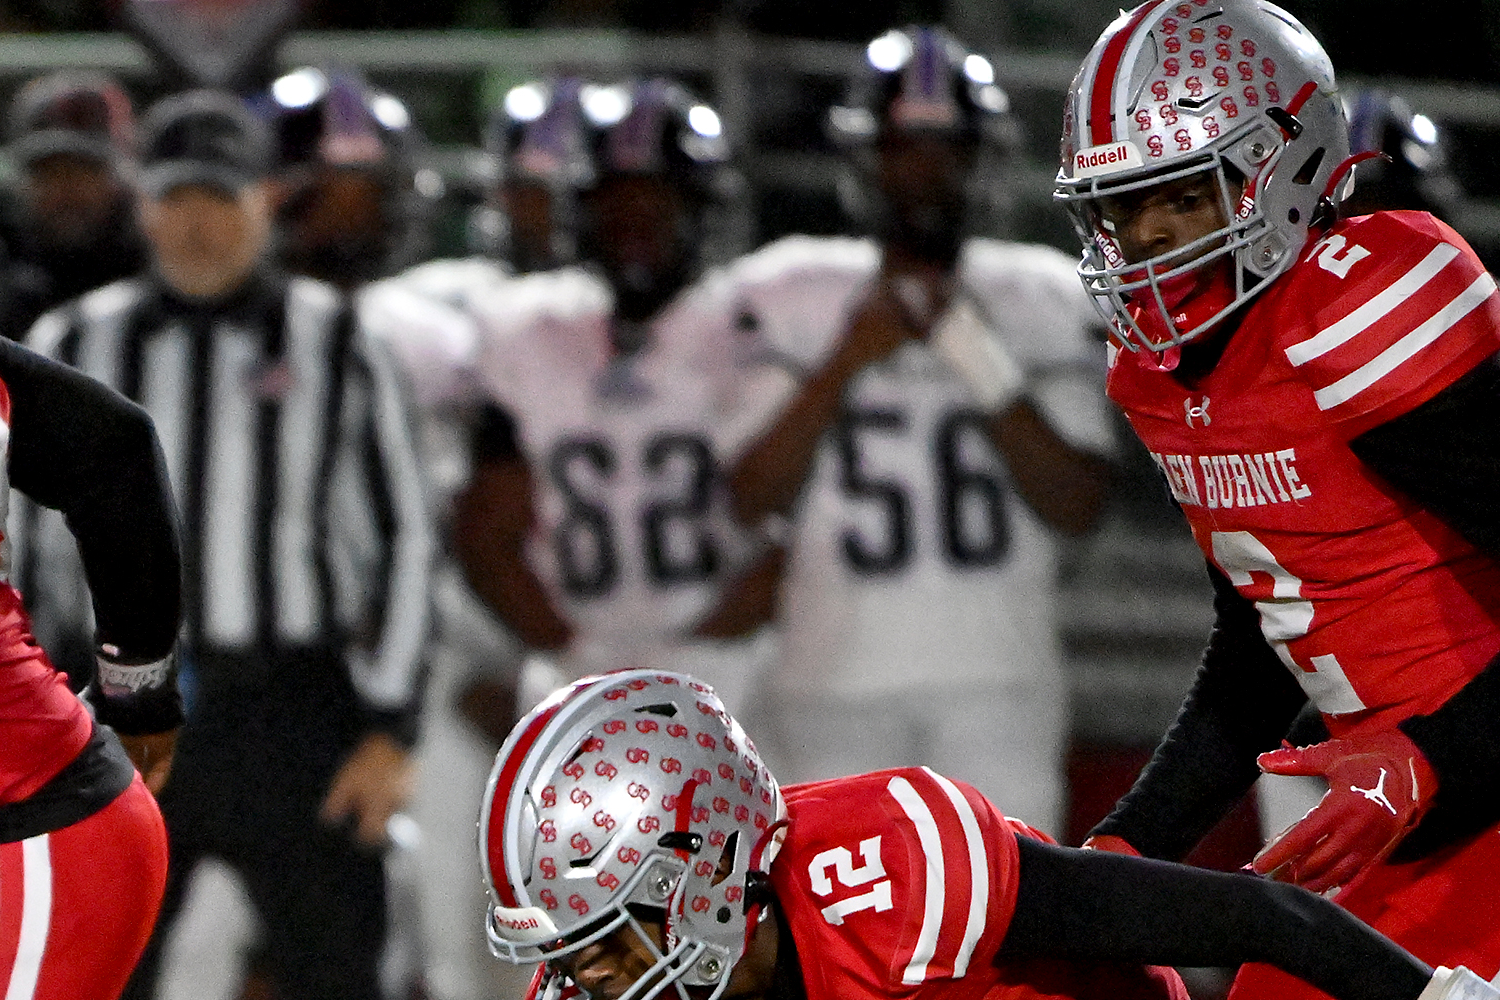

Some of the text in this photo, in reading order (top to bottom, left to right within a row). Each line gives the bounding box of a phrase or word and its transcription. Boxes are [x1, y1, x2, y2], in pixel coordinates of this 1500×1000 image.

[1077, 146, 1128, 169] Riddell
[1304, 234, 1372, 280] 2
[836, 408, 1009, 577] 56
[1199, 448, 1312, 509] BURNIE
[1211, 531, 1367, 718] 2
[808, 835, 893, 926] 12
